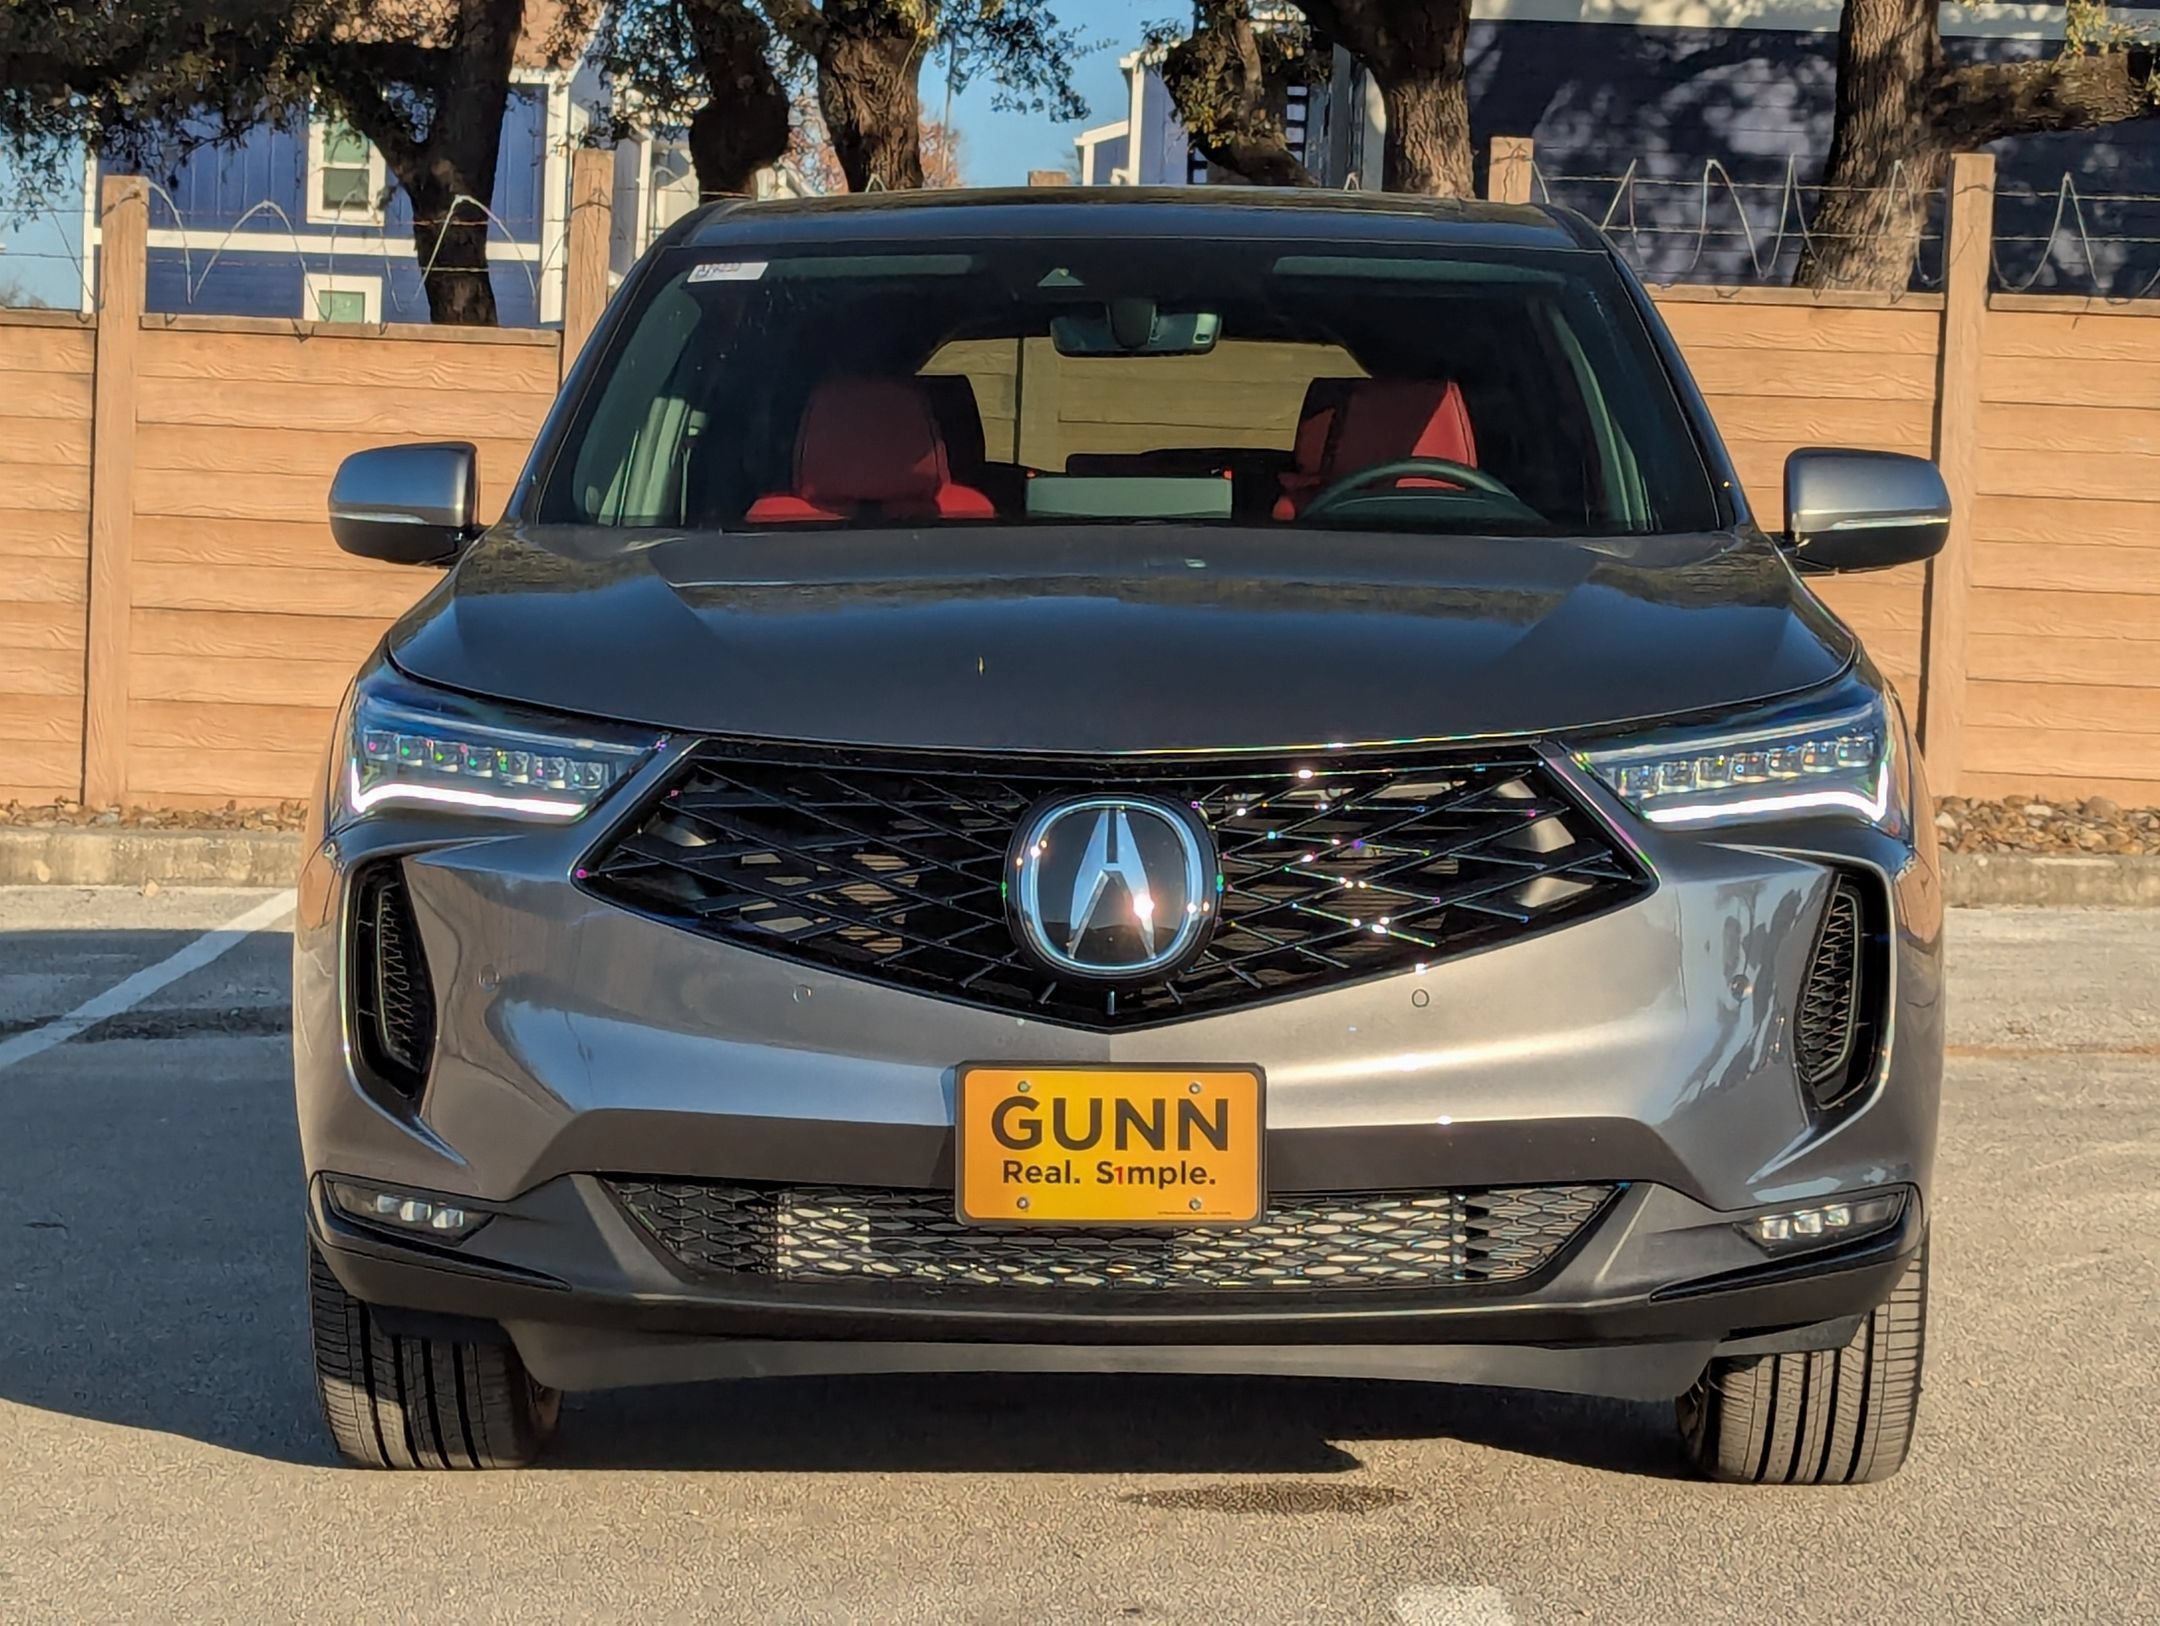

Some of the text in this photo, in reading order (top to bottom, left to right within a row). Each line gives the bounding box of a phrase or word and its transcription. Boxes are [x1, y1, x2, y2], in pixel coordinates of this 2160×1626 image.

[991, 1095, 1229, 1151] GUNN
[1003, 1159, 1216, 1189] Real. S1mple.
